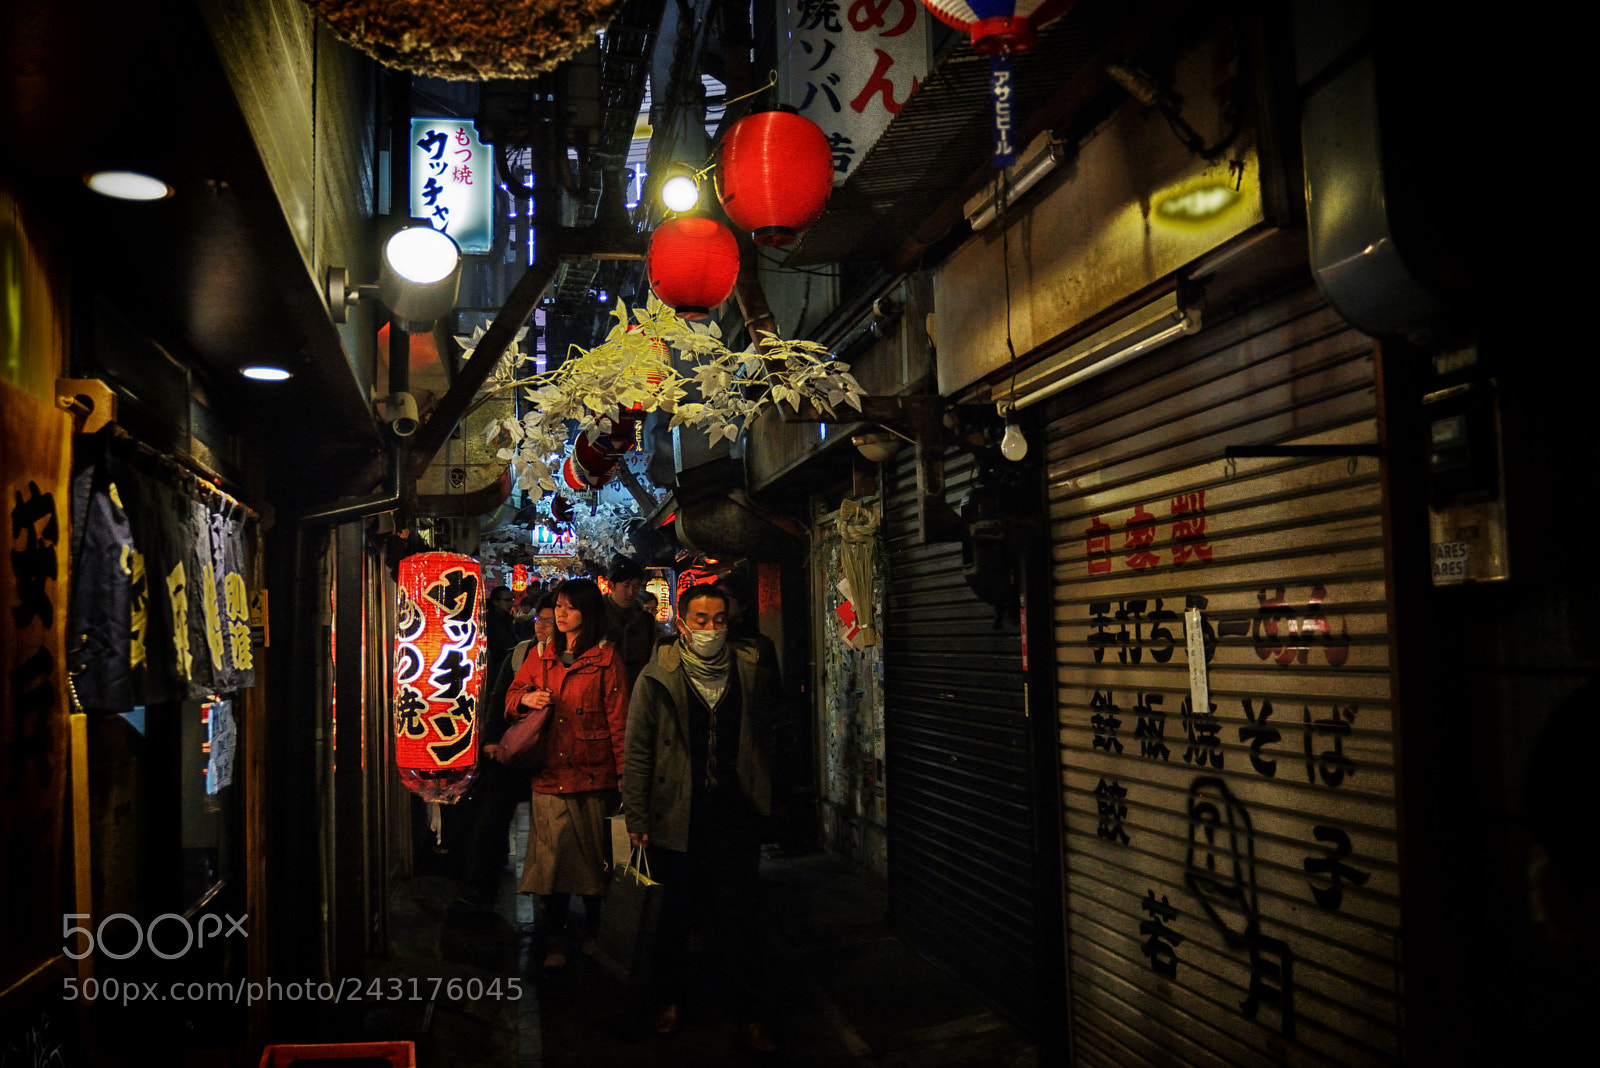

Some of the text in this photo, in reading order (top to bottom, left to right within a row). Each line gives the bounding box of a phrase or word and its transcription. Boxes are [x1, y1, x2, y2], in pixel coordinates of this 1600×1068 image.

[993, 70, 1013, 155] アサヒビール
[416, 130, 449, 233] ウッチャ
[454, 127, 474, 185] もつ焼
[1086, 489, 1212, 574] 自家製
[425, 566, 478, 766] ウッチャン
